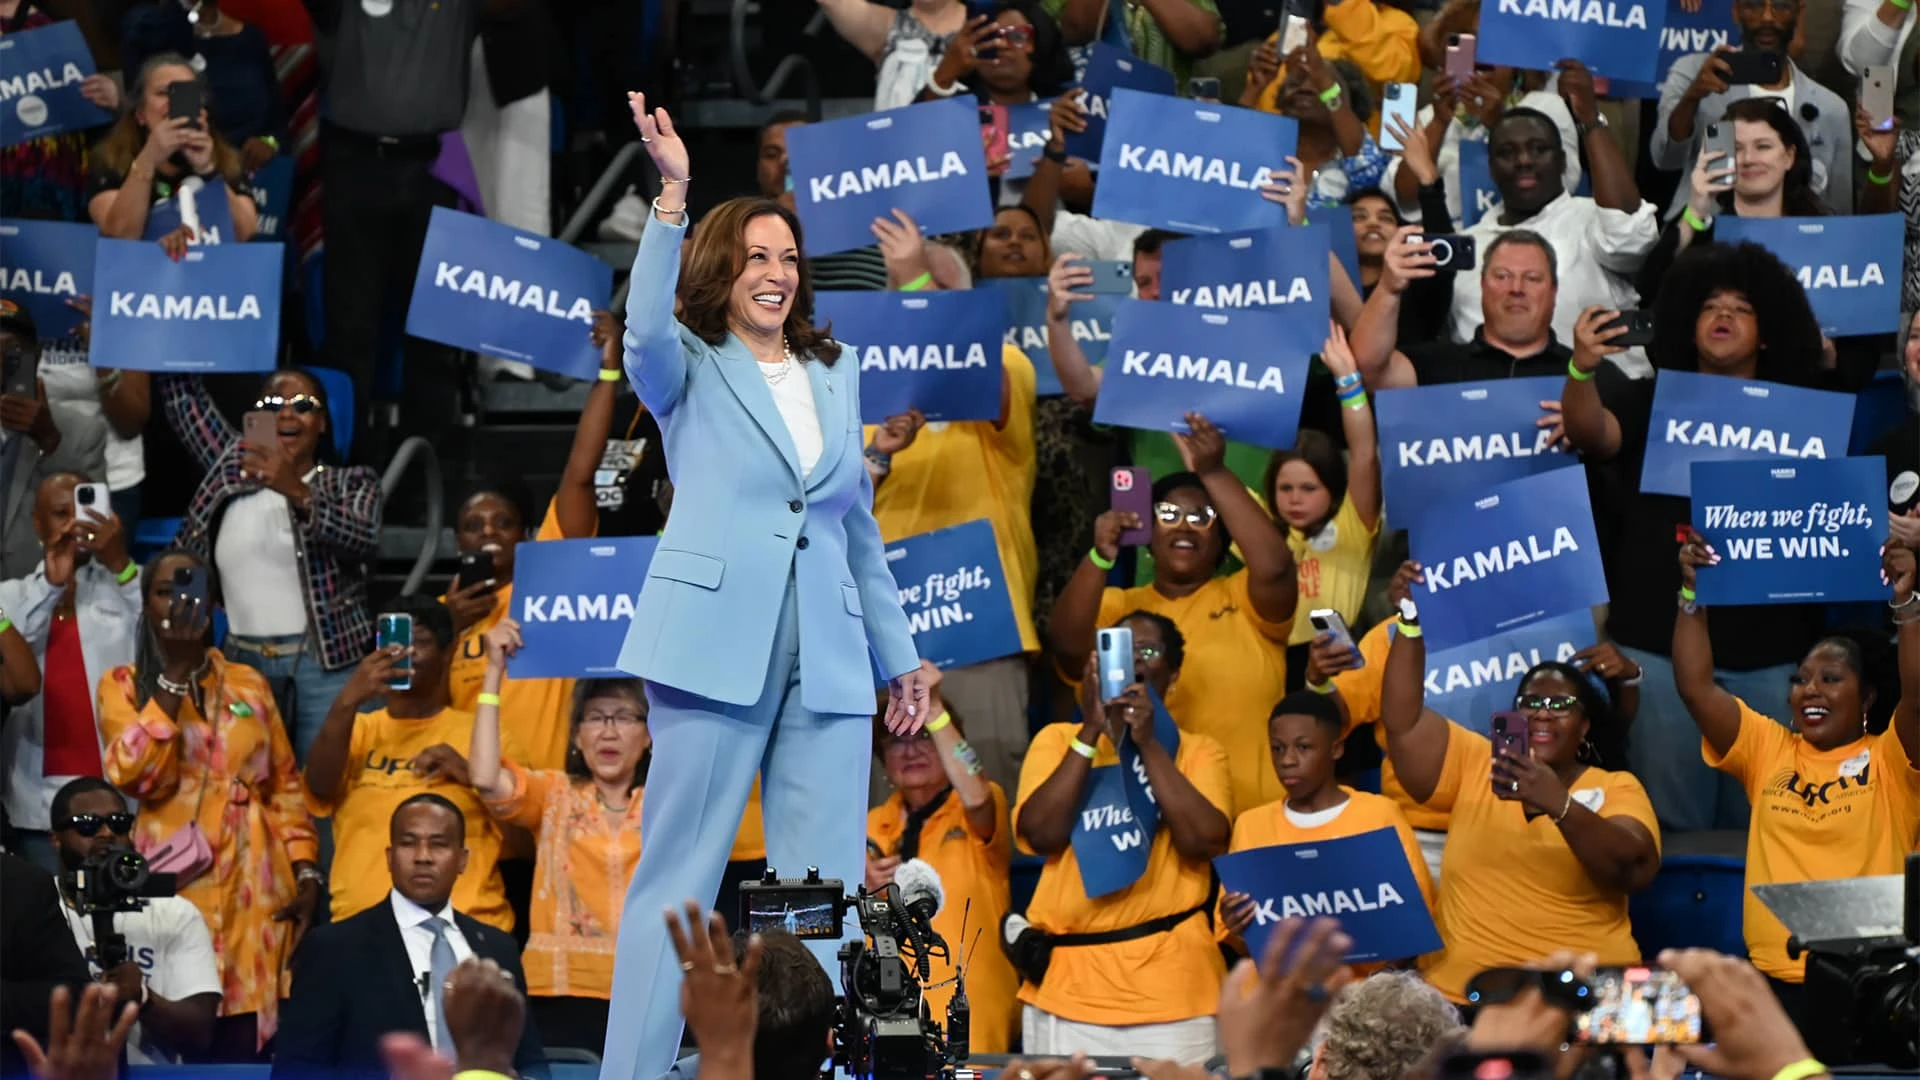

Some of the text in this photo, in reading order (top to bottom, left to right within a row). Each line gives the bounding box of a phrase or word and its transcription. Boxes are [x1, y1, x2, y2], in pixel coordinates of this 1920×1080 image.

[1499, 0, 1646, 30] KAMALA
[0, 62, 84, 101] MALA
[810, 151, 967, 203] KAMALA
[1119, 143, 1273, 191] KAMALA
[0, 268, 77, 296] ALA
[435, 261, 594, 325] KAMALA
[1172, 277, 1312, 309] KAMALA
[110, 291, 261, 321] KAMALA
[1002, 318, 1113, 349] KAAL
[851, 343, 987, 372] AMALA
[1122, 350, 1284, 394] KAMALA
[1398, 428, 1559, 467] KAMALA
[1666, 418, 1826, 459] KAMALA
[1705, 501, 1873, 534] When we fight,
[1425, 526, 1578, 594] KAMALA
[1727, 536, 1849, 560] WE WIN.
[921, 565, 991, 607] fight,
[524, 594, 636, 622] KAMA
[908, 602, 973, 635] WIN.
[1254, 882, 1404, 926] KAMALA
